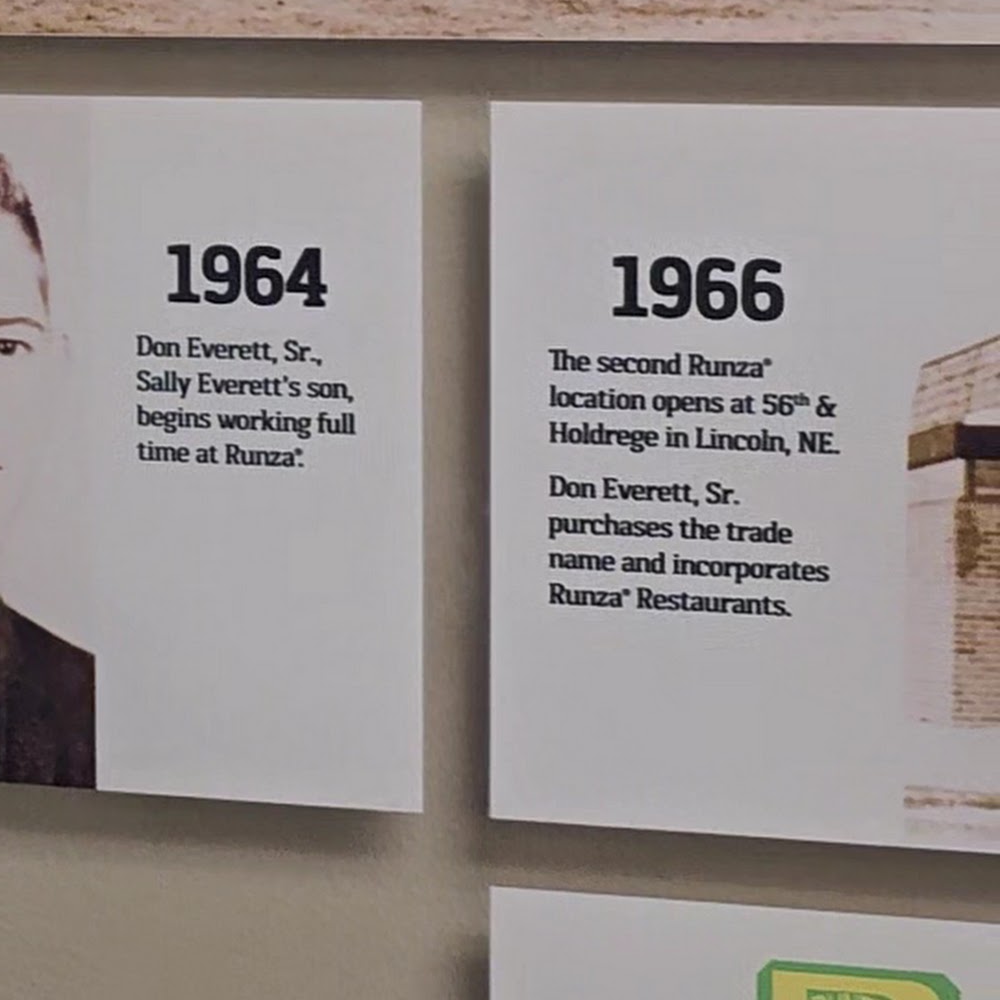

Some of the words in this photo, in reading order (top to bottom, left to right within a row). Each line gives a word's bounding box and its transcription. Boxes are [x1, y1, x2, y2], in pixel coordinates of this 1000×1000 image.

[167, 244, 328, 307] 1964
[612, 255, 785, 321] 1966
[136, 335, 181, 358] Don
[187, 337, 278, 364] Everett,
[283, 340, 322, 366] Sr.,
[548, 349, 590, 372] The
[597, 353, 681, 376] second
[136, 370, 191, 399] Sally
[197, 372, 300, 397] Everett's
[307, 382, 354, 403] son,
[549, 385, 646, 410] location
[652, 394, 724, 417] opens
[730, 395, 755, 414] at
[815, 395, 836, 418] &
[137, 405, 211, 433] begins
[217, 410, 311, 439] working
[317, 412, 355, 435] full
[137, 441, 190, 463] time
[196, 445, 218, 464] at
[549, 422, 659, 452] Holdrege
[666, 427, 689, 448] in
[695, 427, 791, 456] Lincoln,
[798, 431, 840, 455] NE.
[549, 475, 596, 498] Don
[602, 478, 699, 507] Everett,
[705, 482, 740, 505] Sr.
[548, 513, 672, 539] purchases
[679, 518, 720, 541] the
[727, 521, 793, 544] trade
[549, 552, 615, 571] name
[621, 553, 666, 574] and
[672, 554, 830, 584] incorporates
[637, 587, 792, 617] Restaurants.
